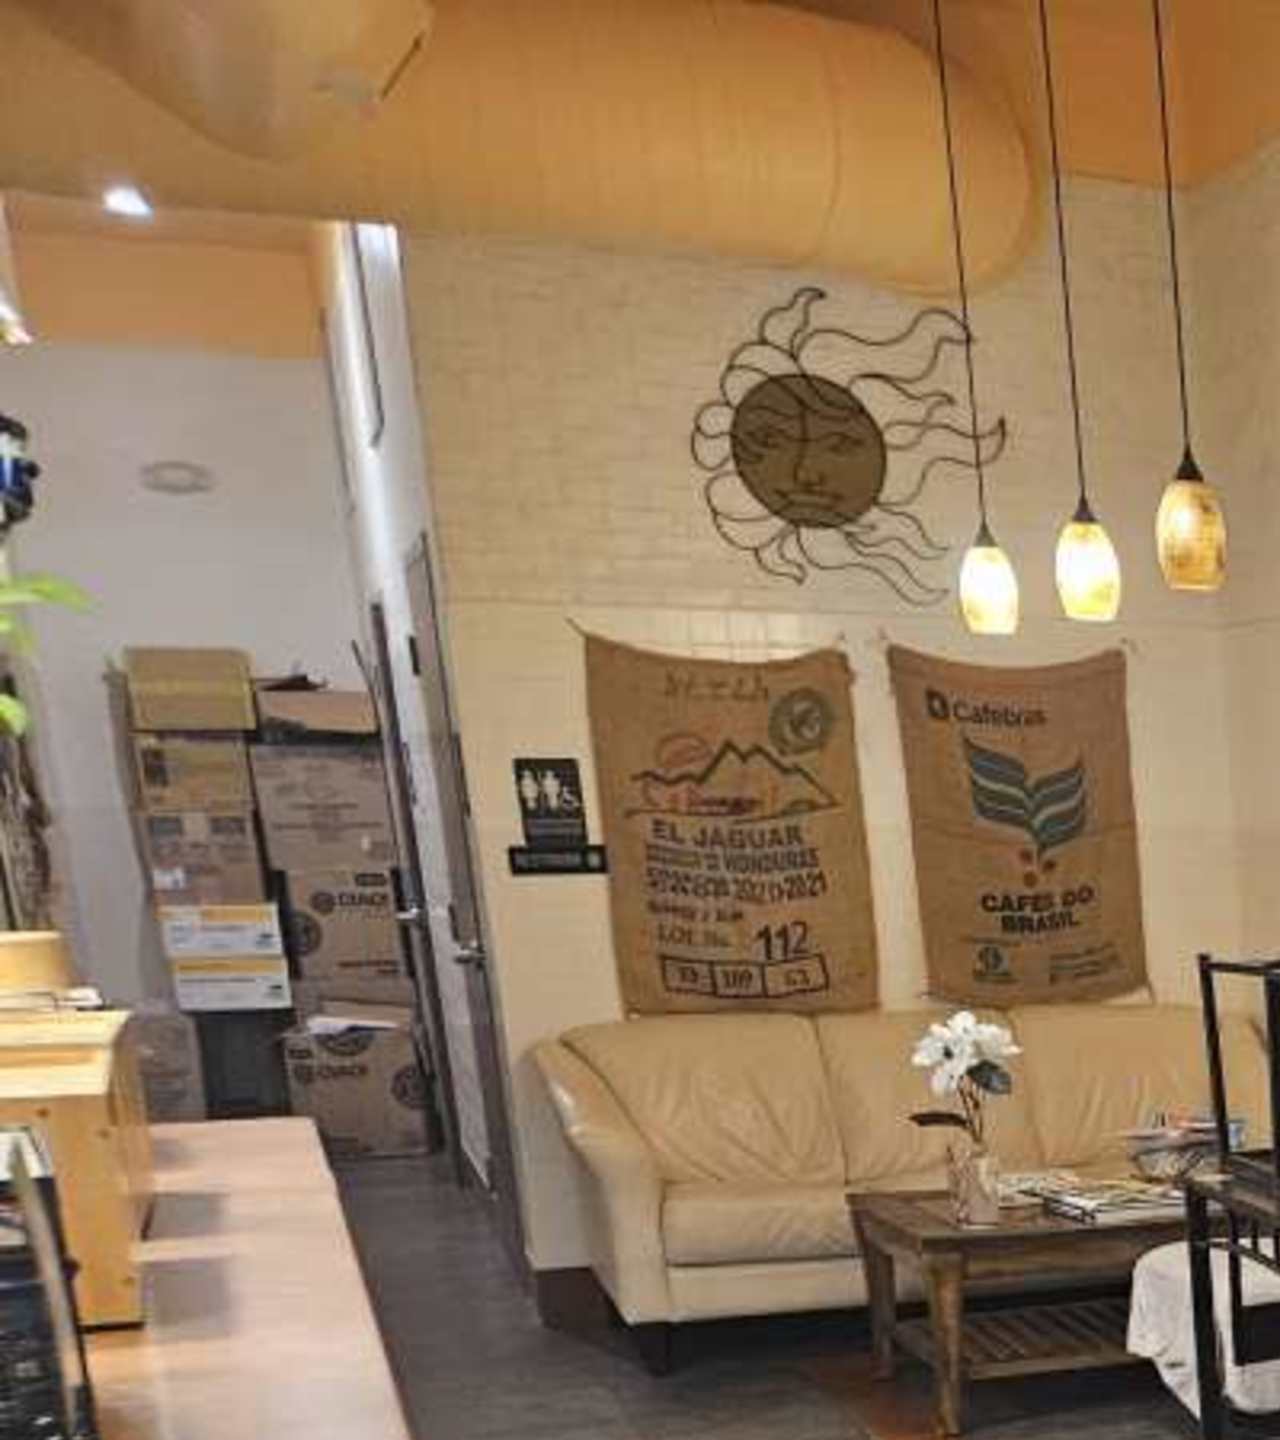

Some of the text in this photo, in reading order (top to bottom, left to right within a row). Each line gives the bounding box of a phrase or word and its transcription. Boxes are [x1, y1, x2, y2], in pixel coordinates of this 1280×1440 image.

[652, 819, 803, 848] EL JAGUAR
[1001, 911, 1081, 934] BRASIL
[757, 920, 808, 960] 112
